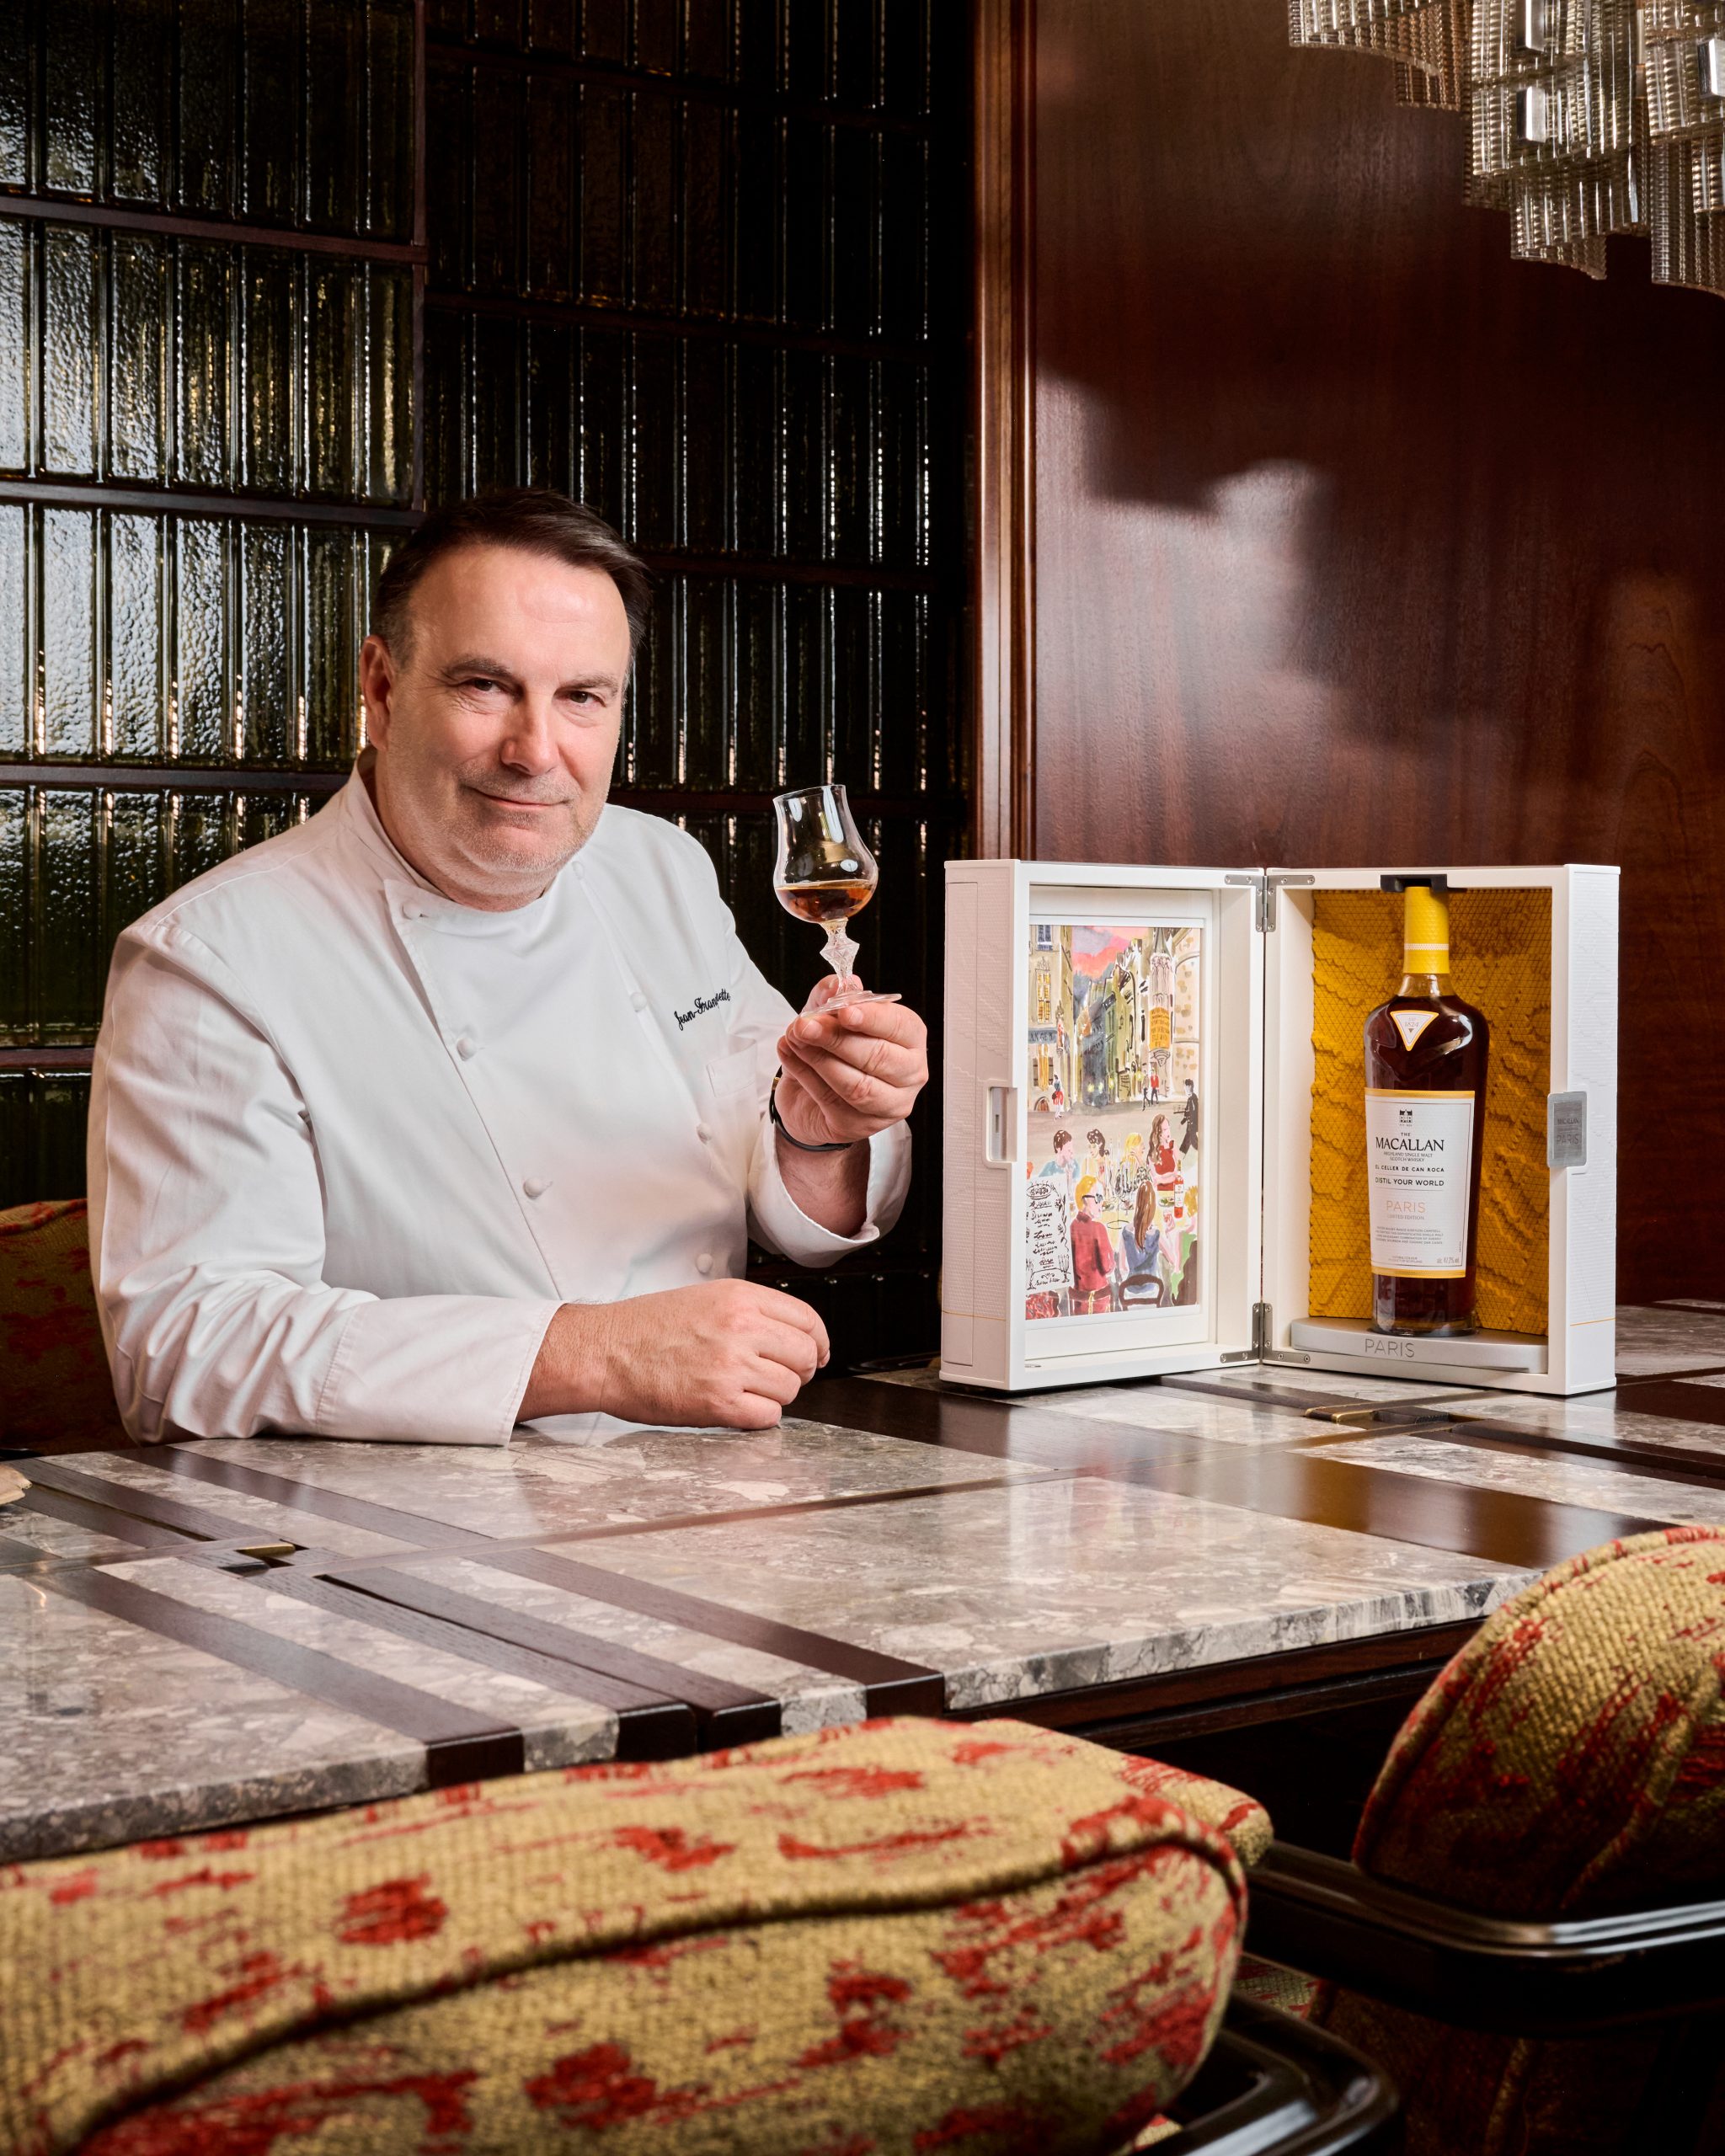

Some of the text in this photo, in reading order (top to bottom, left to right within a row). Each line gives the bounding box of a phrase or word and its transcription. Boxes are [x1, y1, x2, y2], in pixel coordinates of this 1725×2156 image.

[1375, 1137, 1445, 1151] MACALLAN
[1556, 1134, 1580, 1146] PARIS
[1386, 1200, 1426, 1214] PARIS
[1365, 1338, 1415, 1358] PARIS
